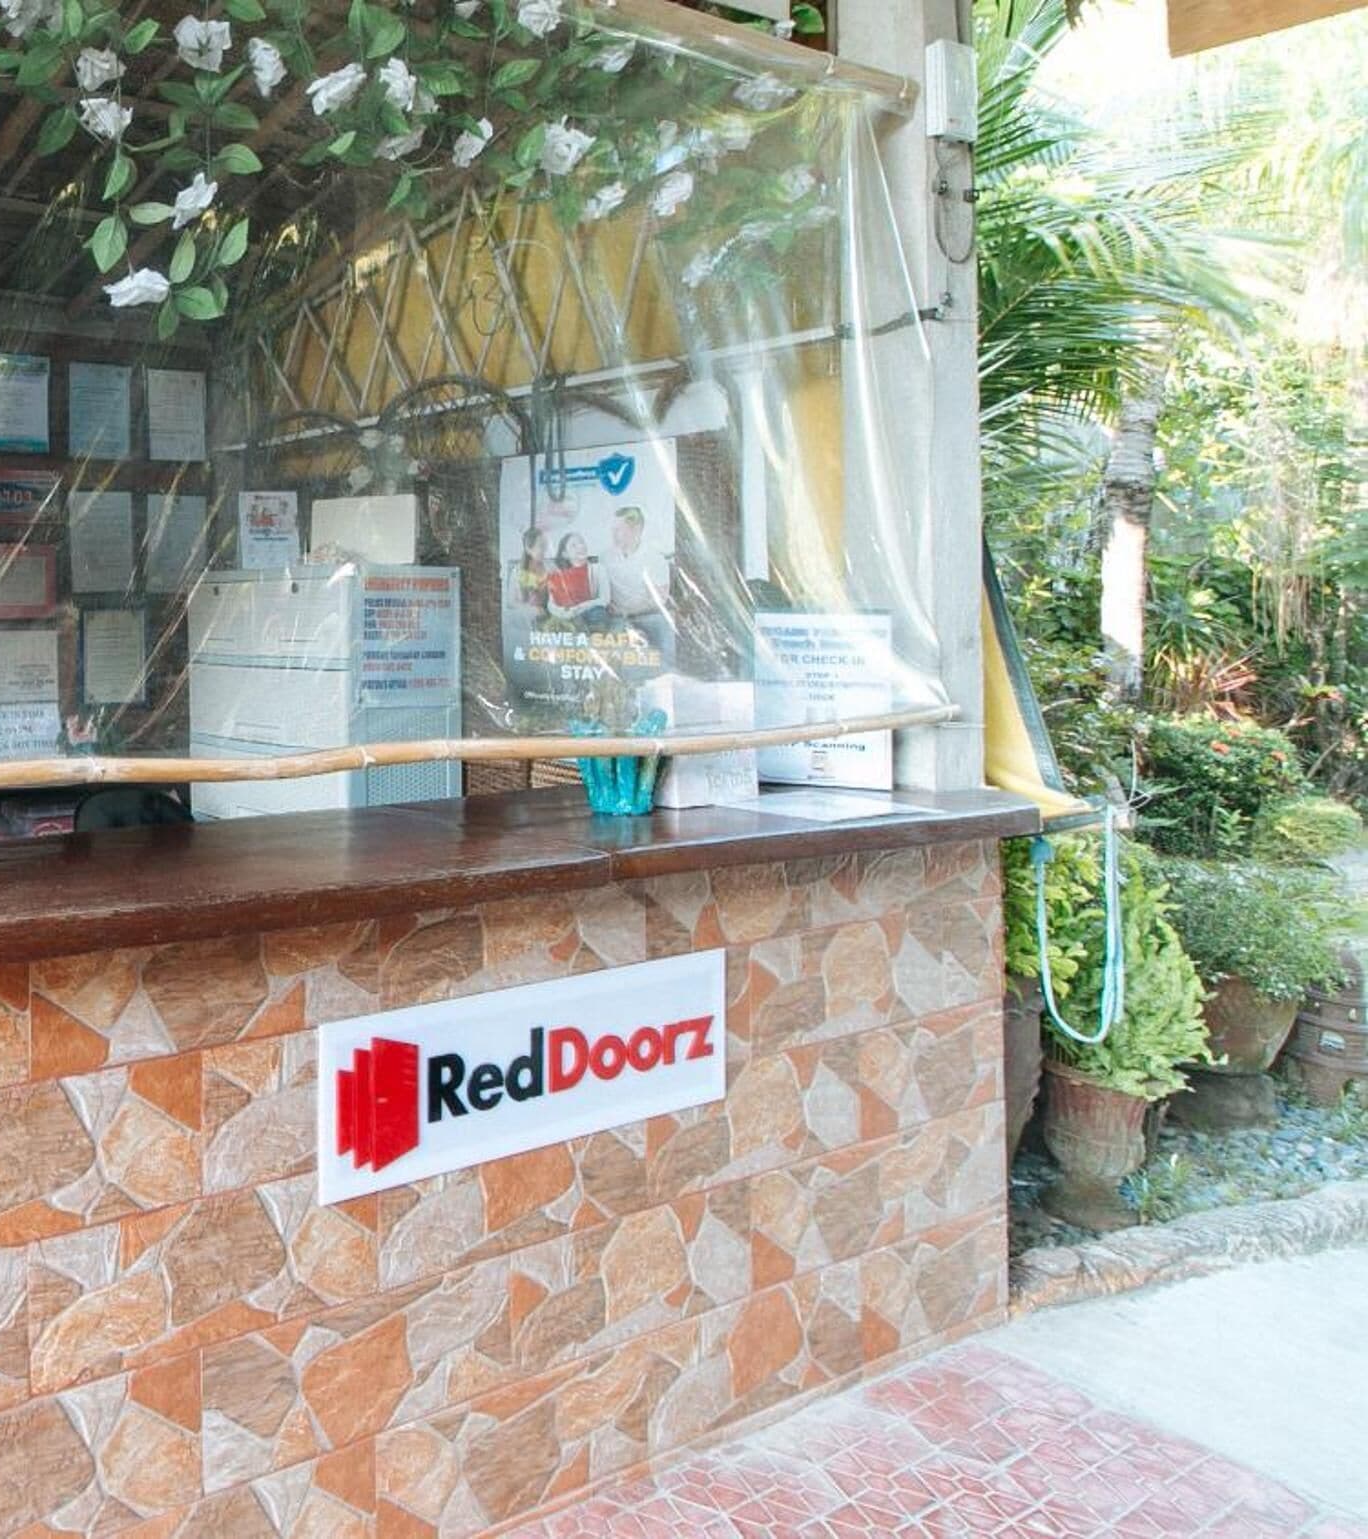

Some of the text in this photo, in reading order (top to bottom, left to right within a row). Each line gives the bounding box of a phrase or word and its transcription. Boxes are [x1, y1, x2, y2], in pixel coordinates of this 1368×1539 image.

[529, 632, 574, 647] HAVE
[576, 632, 589, 648] A
[513, 646, 526, 661] &
[801, 654, 849, 665] CHECK
[560, 665, 603, 680] STAY
[427, 1014, 715, 1124] RedDoorz
